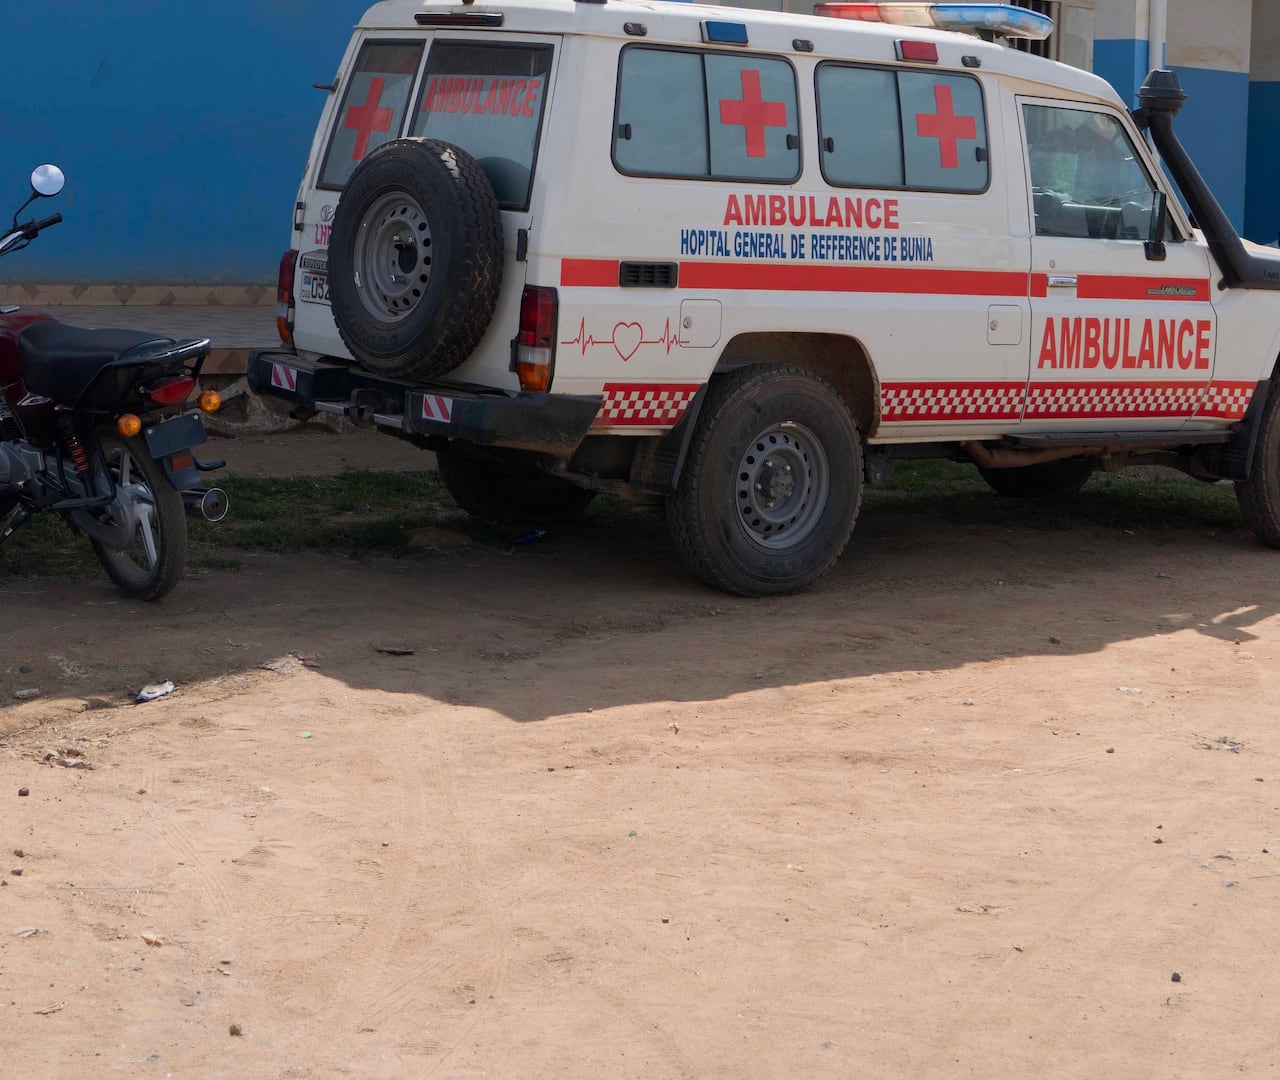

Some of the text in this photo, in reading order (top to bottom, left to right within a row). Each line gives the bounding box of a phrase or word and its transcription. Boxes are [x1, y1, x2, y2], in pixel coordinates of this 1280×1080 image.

[421, 76, 540, 118] AMBULANCE
[723, 194, 900, 229] AMBULANCE
[681, 229, 934, 262] HOPITAL GENERAL DE REFFERENCE DE BUNIA
[304, 258, 327, 270] TOYOTA
[1037, 317, 1211, 370] AMBULANCE
